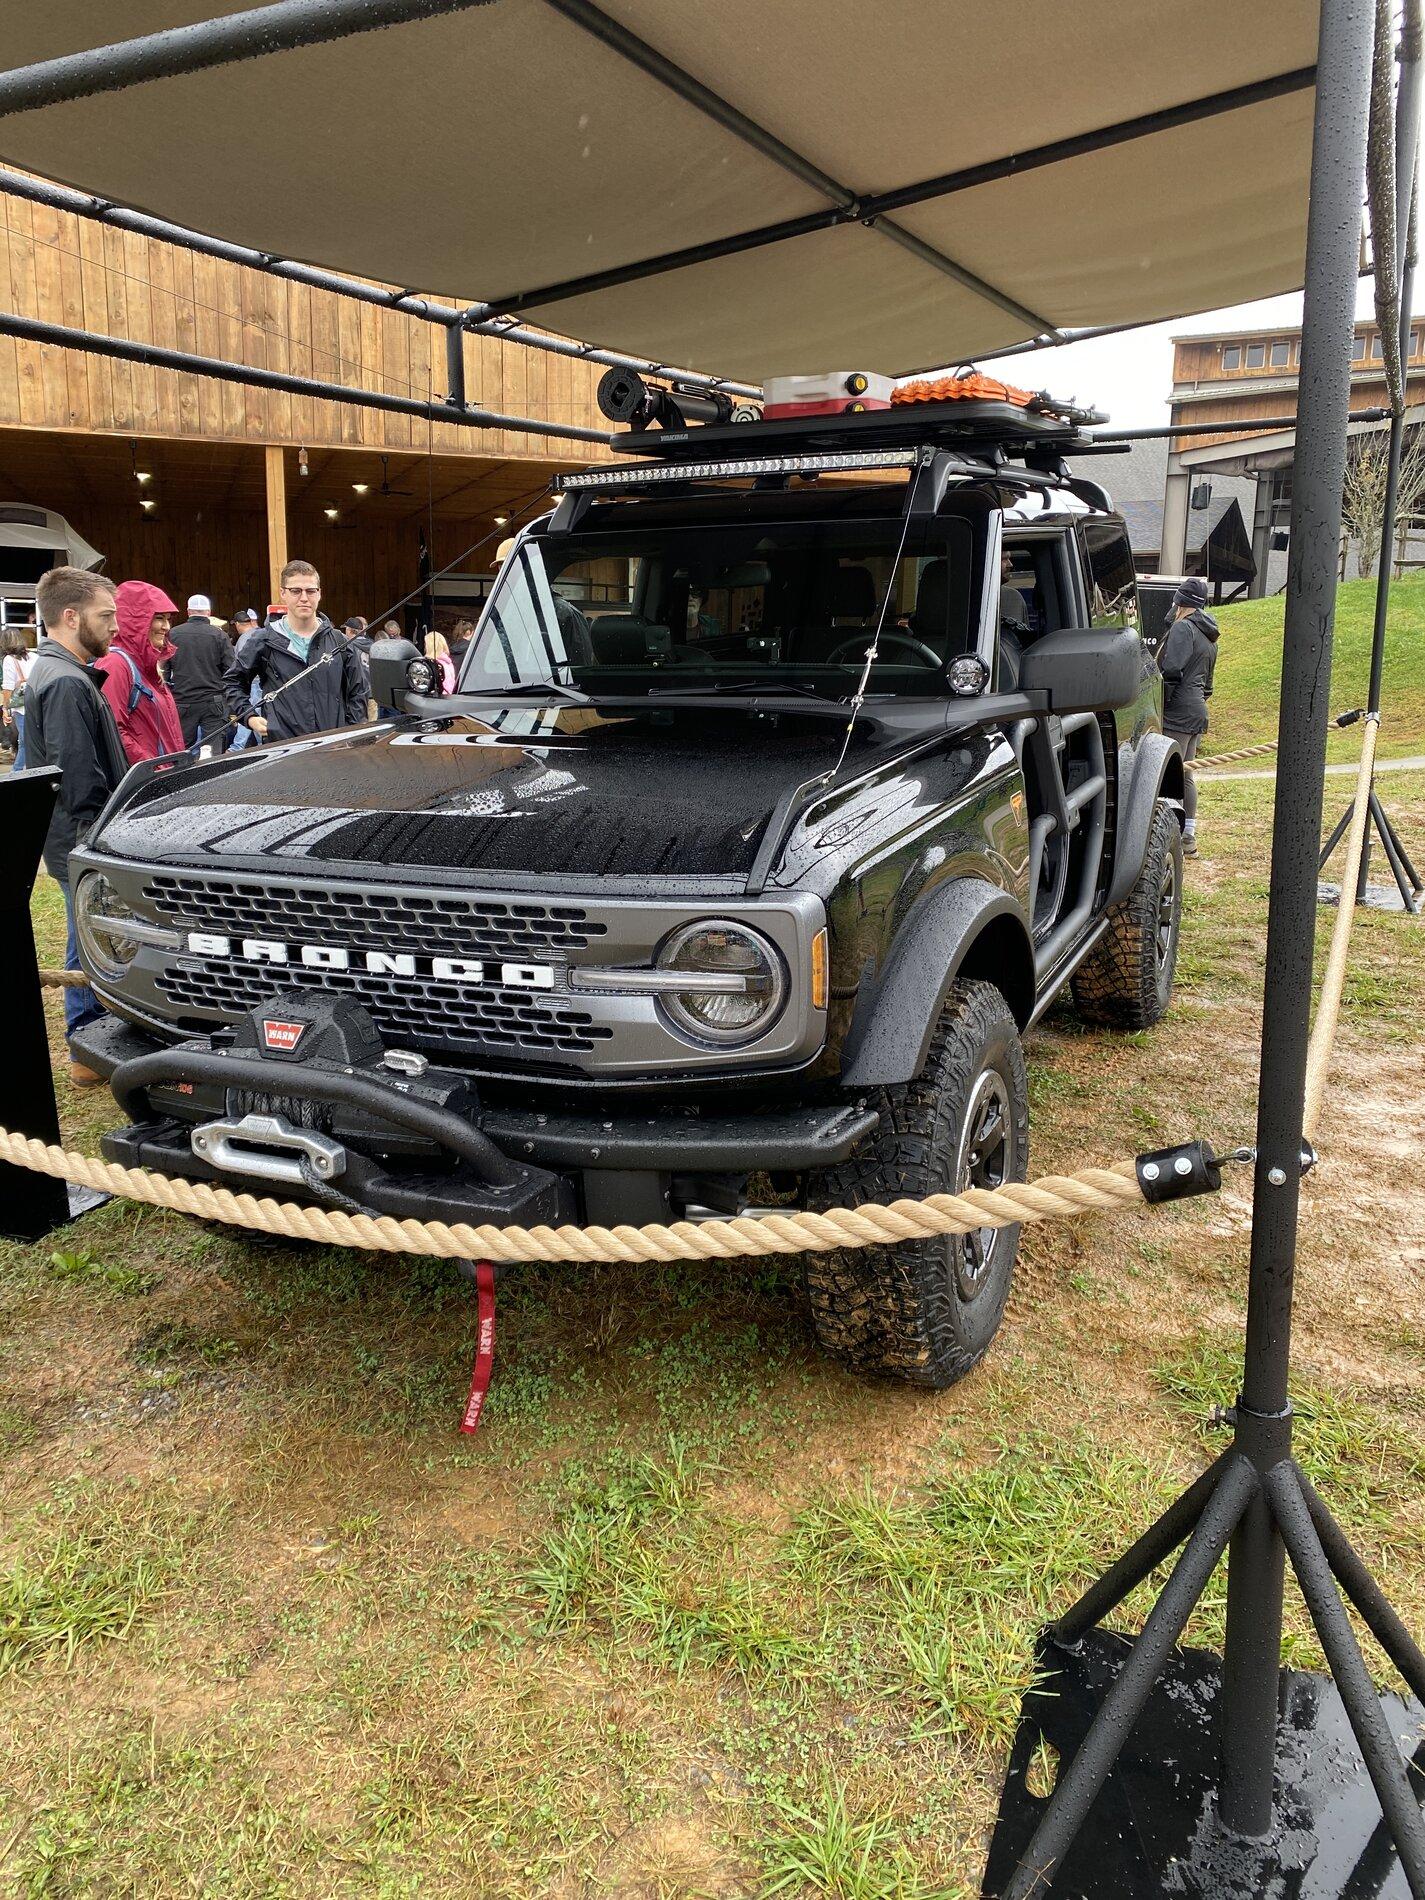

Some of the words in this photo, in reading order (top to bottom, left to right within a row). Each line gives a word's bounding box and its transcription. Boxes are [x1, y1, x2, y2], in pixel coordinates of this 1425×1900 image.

[188, 932, 555, 988] BRONCO
[268, 1029, 295, 1042] WARN
[480, 1317, 493, 1354] WARN
[464, 1391, 484, 1427] WARN
